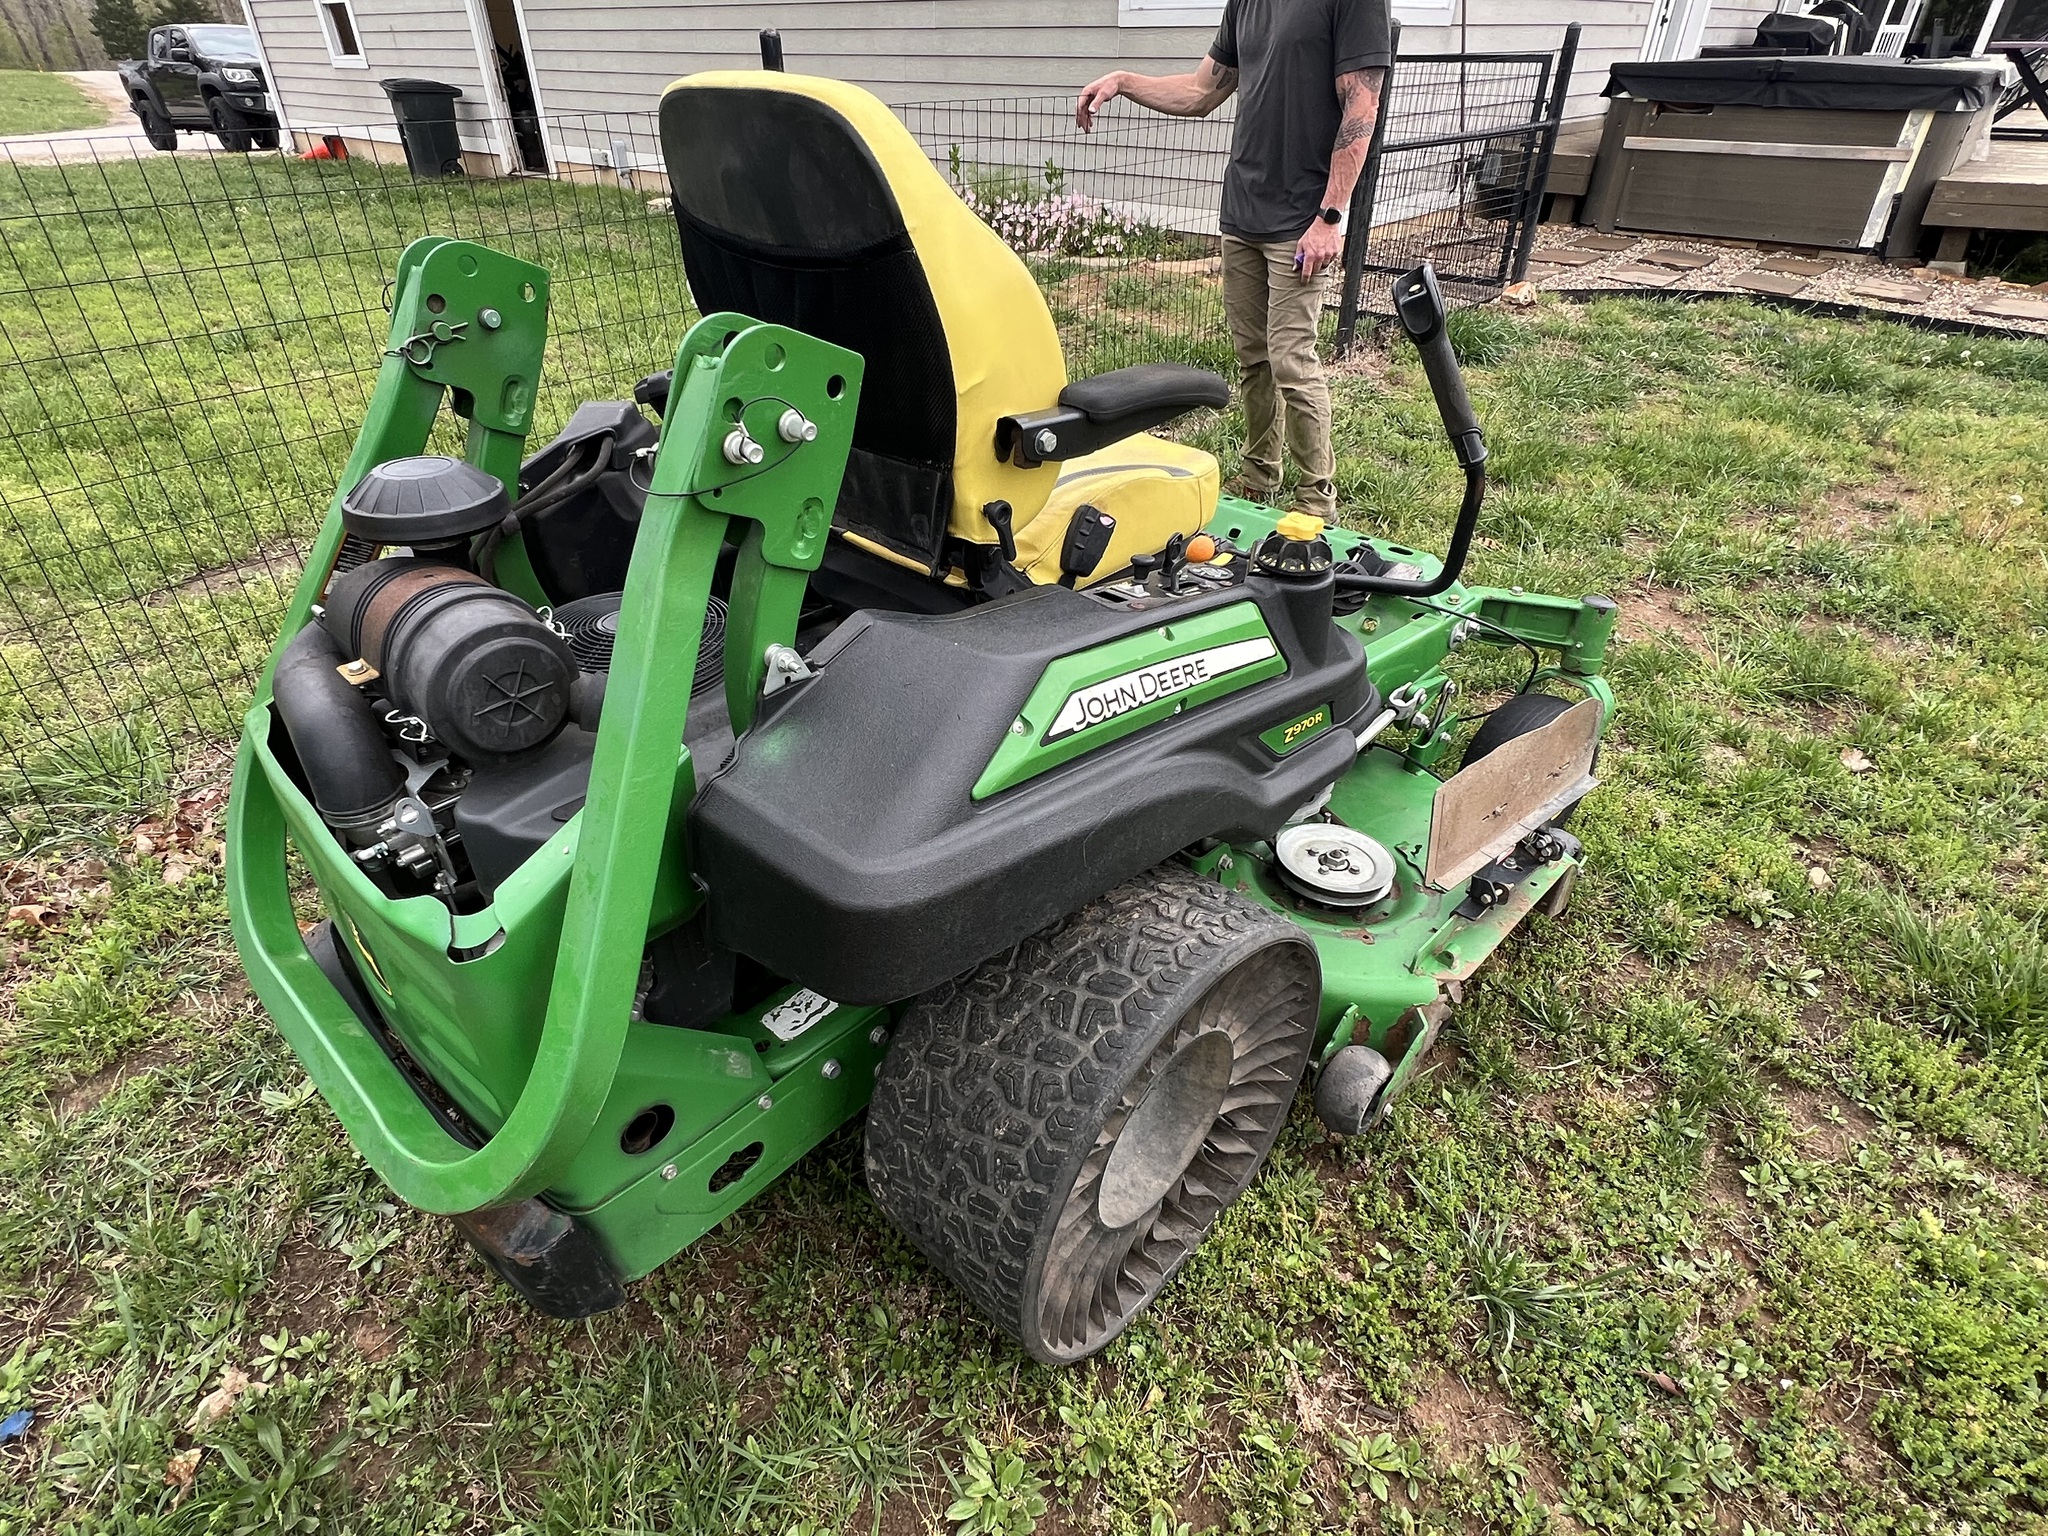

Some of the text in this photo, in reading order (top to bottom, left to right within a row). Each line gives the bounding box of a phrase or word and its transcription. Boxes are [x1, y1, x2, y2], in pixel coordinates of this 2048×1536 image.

[1076, 659, 1209, 726] JOHN DEERE
[1284, 711, 1324, 744] Z970R
